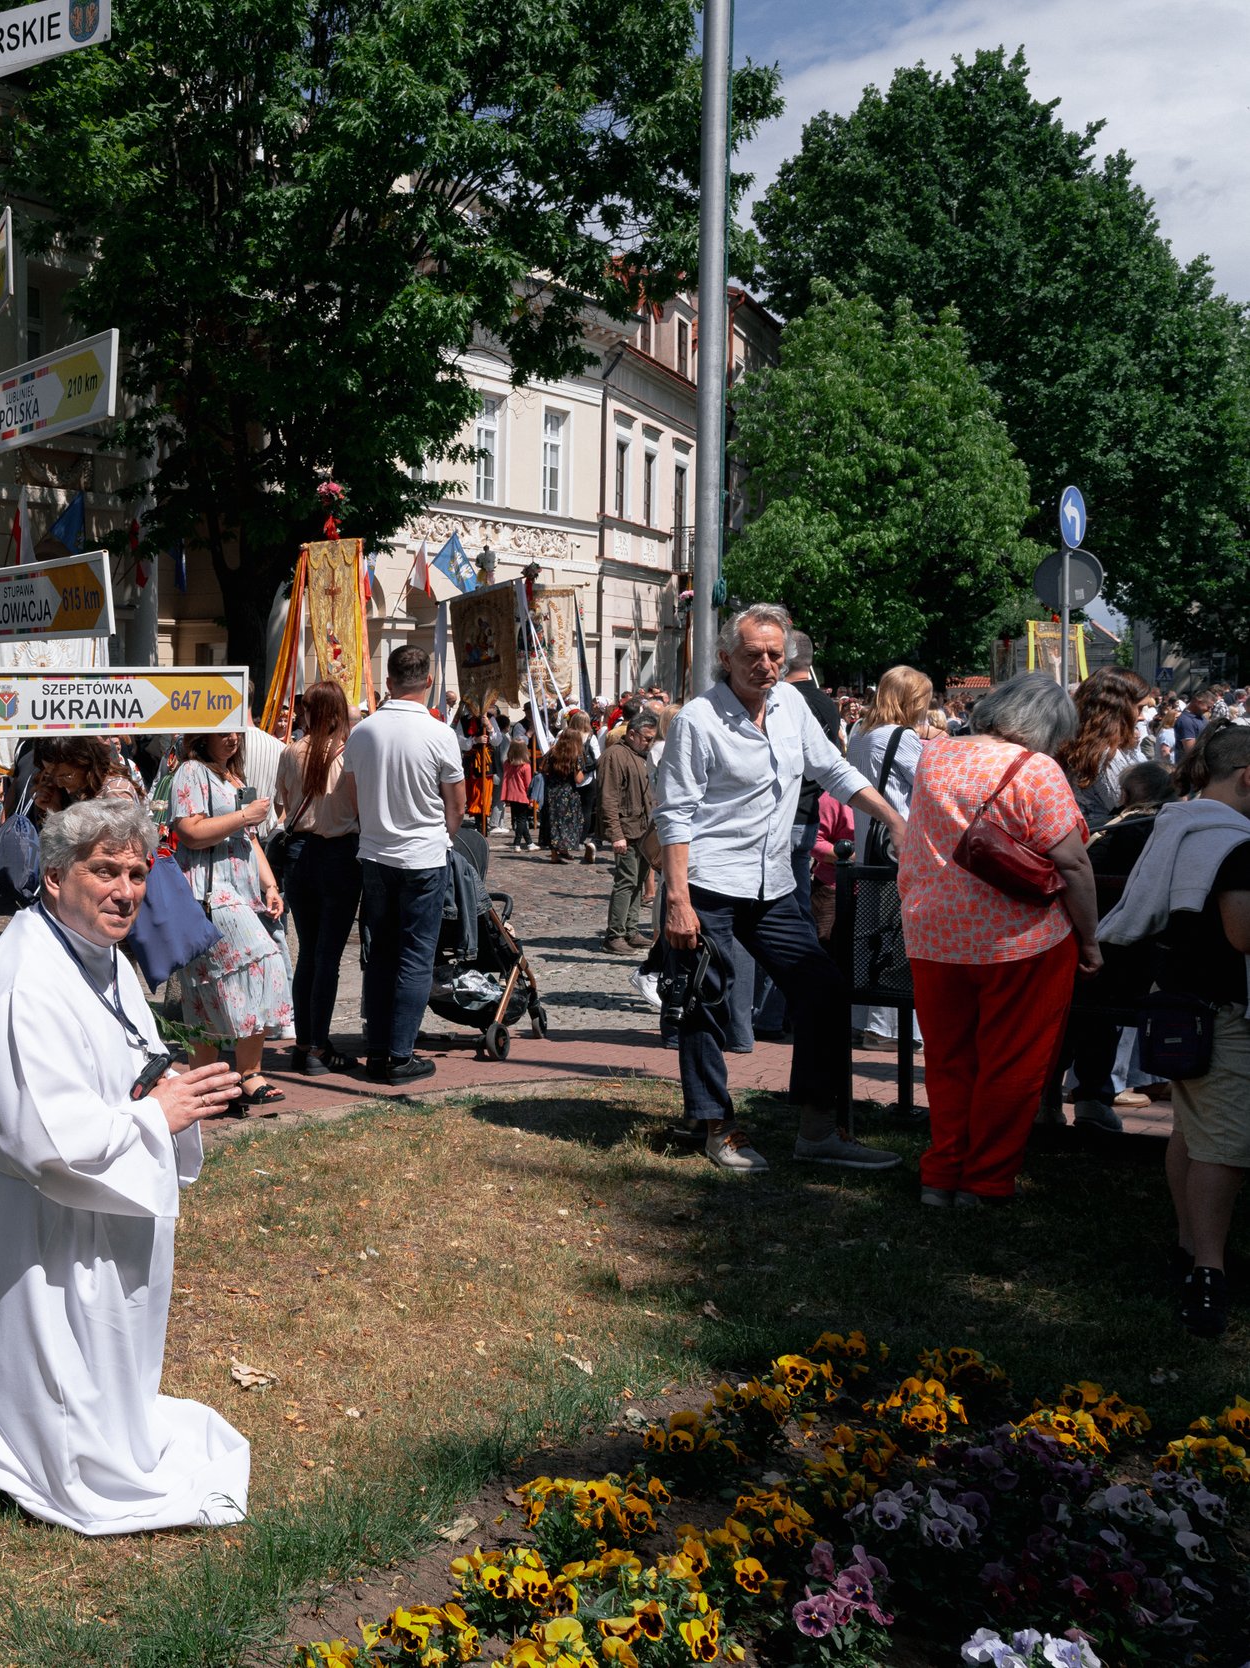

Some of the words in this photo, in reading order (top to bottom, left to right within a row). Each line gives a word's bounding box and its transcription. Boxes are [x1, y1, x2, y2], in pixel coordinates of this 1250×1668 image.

[5, 384, 35, 405] LUBLINIEC
[67, 378, 82, 399] 210
[84, 372, 98, 392] km
[0, 397, 40, 430] POLSKA
[3, 584, 35, 599] STUPAWA
[62, 587, 81, 612] 615
[84, 585, 101, 608] km
[42, 681, 133, 696] SZEPETÓWKA
[31, 698, 144, 721] UKRAINA
[170, 690, 201, 711] 647
[207, 691, 233, 710] km
